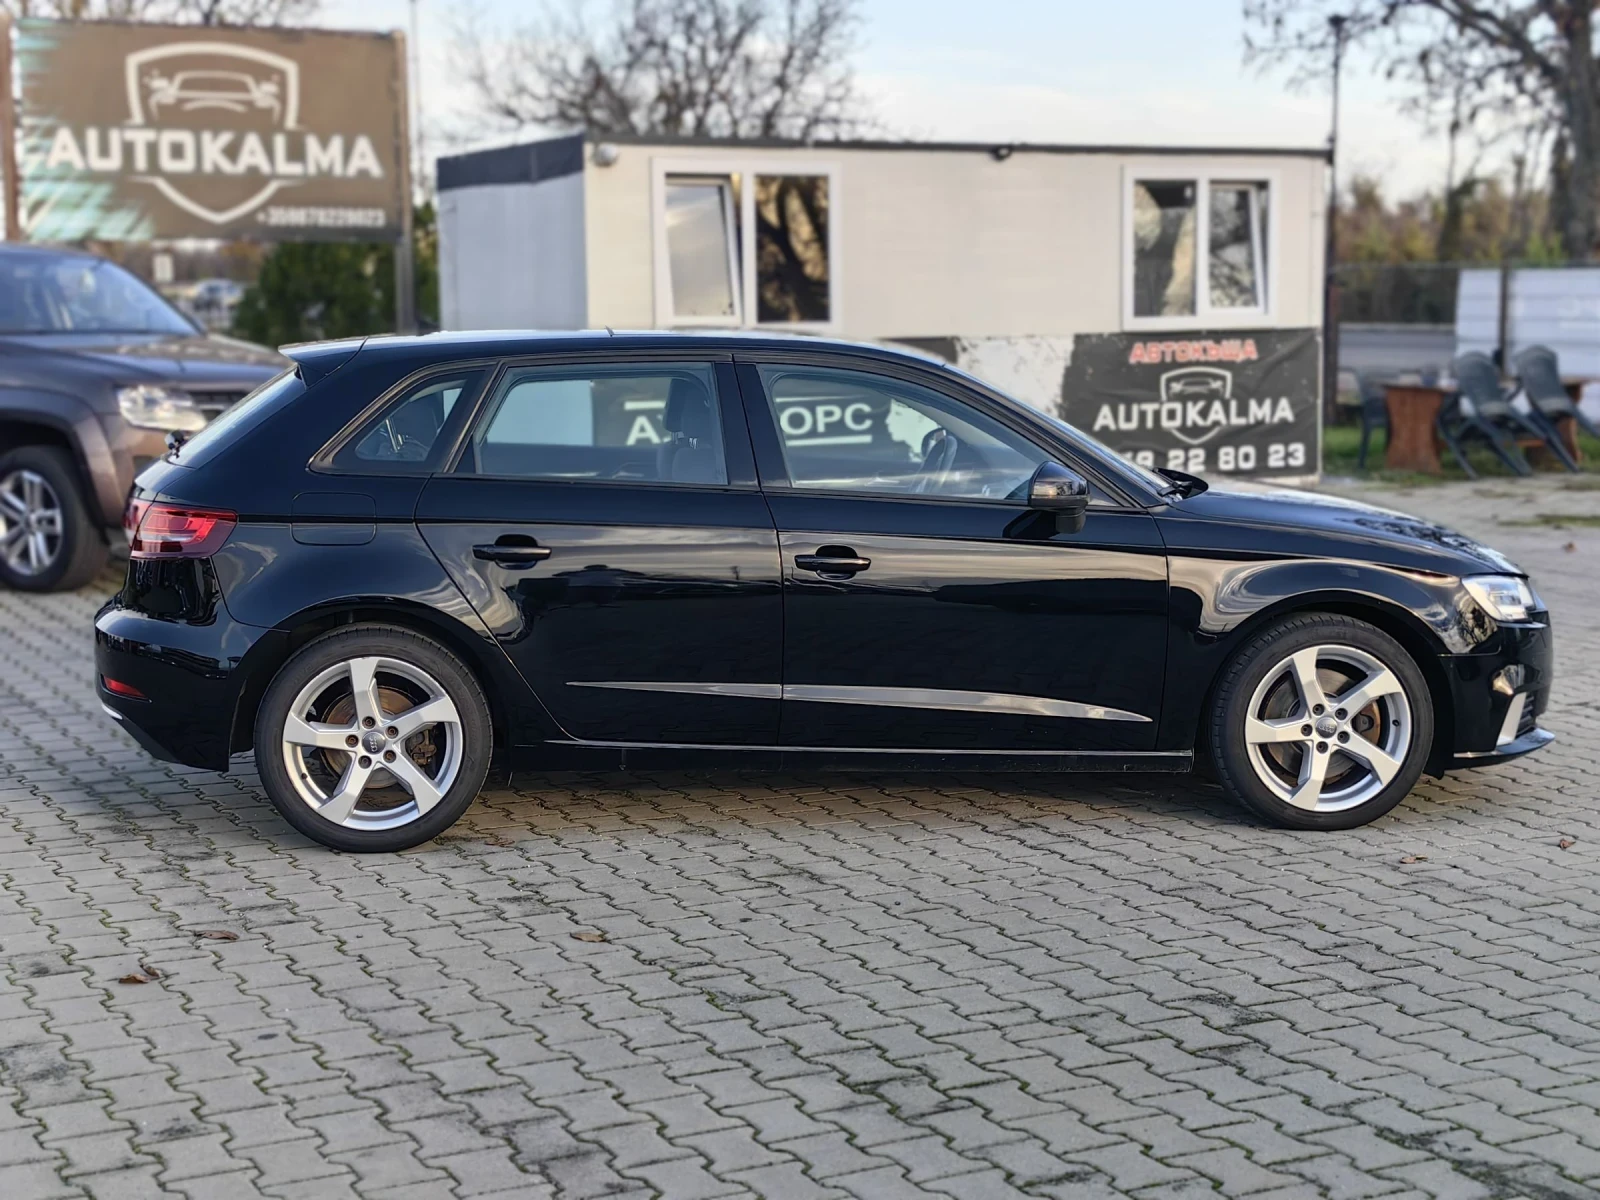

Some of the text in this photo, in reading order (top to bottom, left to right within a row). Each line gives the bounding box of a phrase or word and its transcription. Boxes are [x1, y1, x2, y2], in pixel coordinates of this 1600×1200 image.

[46, 126, 384, 178] AUTOKALMA
[1128, 338, 1258, 364] АВТОКЪЩА
[1093, 397, 1295, 431] AUTOKALMA
[1167, 447, 1206, 474] 22
[1217, 445, 1256, 471] 80
[1267, 442, 1306, 467] 23
